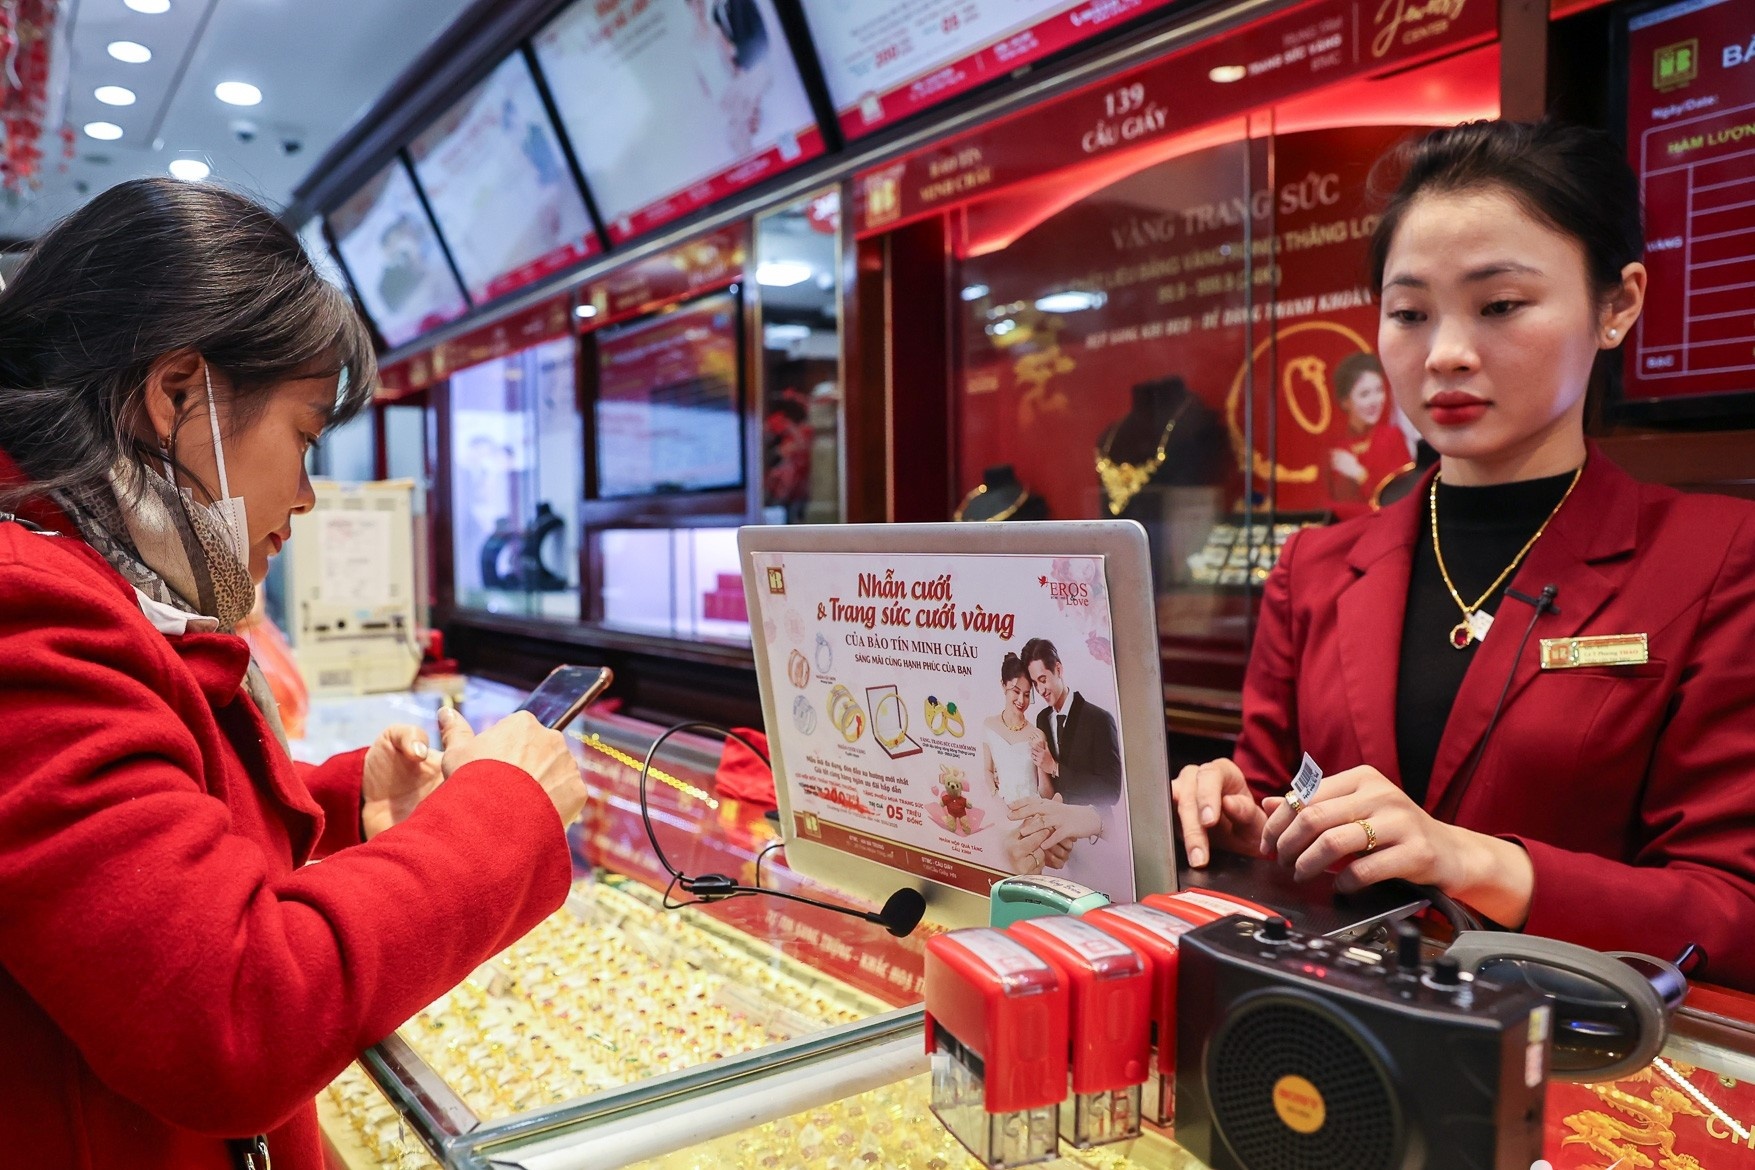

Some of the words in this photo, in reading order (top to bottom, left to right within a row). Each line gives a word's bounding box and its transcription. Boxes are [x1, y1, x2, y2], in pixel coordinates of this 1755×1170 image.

[1104, 82, 1145, 117] 139
[1081, 119, 1119, 153] CẦU
[1121, 101, 1168, 140] GIẤY
[1111, 217, 1175, 250] VÀNG
[1184, 191, 1271, 236] TRANG
[1279, 171, 1340, 214] SỨC
[1350, 214, 1382, 239] LO
[858, 568, 907, 600] Nhẫn
[911, 574, 953, 602] cưới
[1050, 582, 1088, 598] EROS
[1066, 595, 1089, 606] Love
[817, 602, 827, 620] &
[828, 597, 876, 630] Trang
[880, 601, 911, 627] sức
[915, 603, 957, 630] cưới
[961, 604, 1015, 641] vàng
[845, 631, 865, 647] CỦA
[867, 633, 889, 650] BẢO
[890, 635, 909, 651] TÍN
[911, 641, 942, 656] MINH
[944, 641, 978, 659] CHÂU
[884, 656, 902, 668] CÙNG
[903, 660, 922, 671] HẠNH
[923, 660, 941, 673] PHÚC
[941, 661, 956, 674] CỦA
[957, 665, 972, 676] BẠN
[880, 781, 891, 792] hấp
[891, 784, 902, 794] dẫn
[885, 774, 896, 783] mới
[896, 777, 909, 786] nhất
[898, 798, 915, 807] TRANG
[914, 801, 924, 809] SỨC
[886, 804, 903, 820] 05
[906, 809, 922, 818] TRIỆU
[906, 816, 923, 826] ĐỒNG
[971, 844, 983, 853] TẶNG
